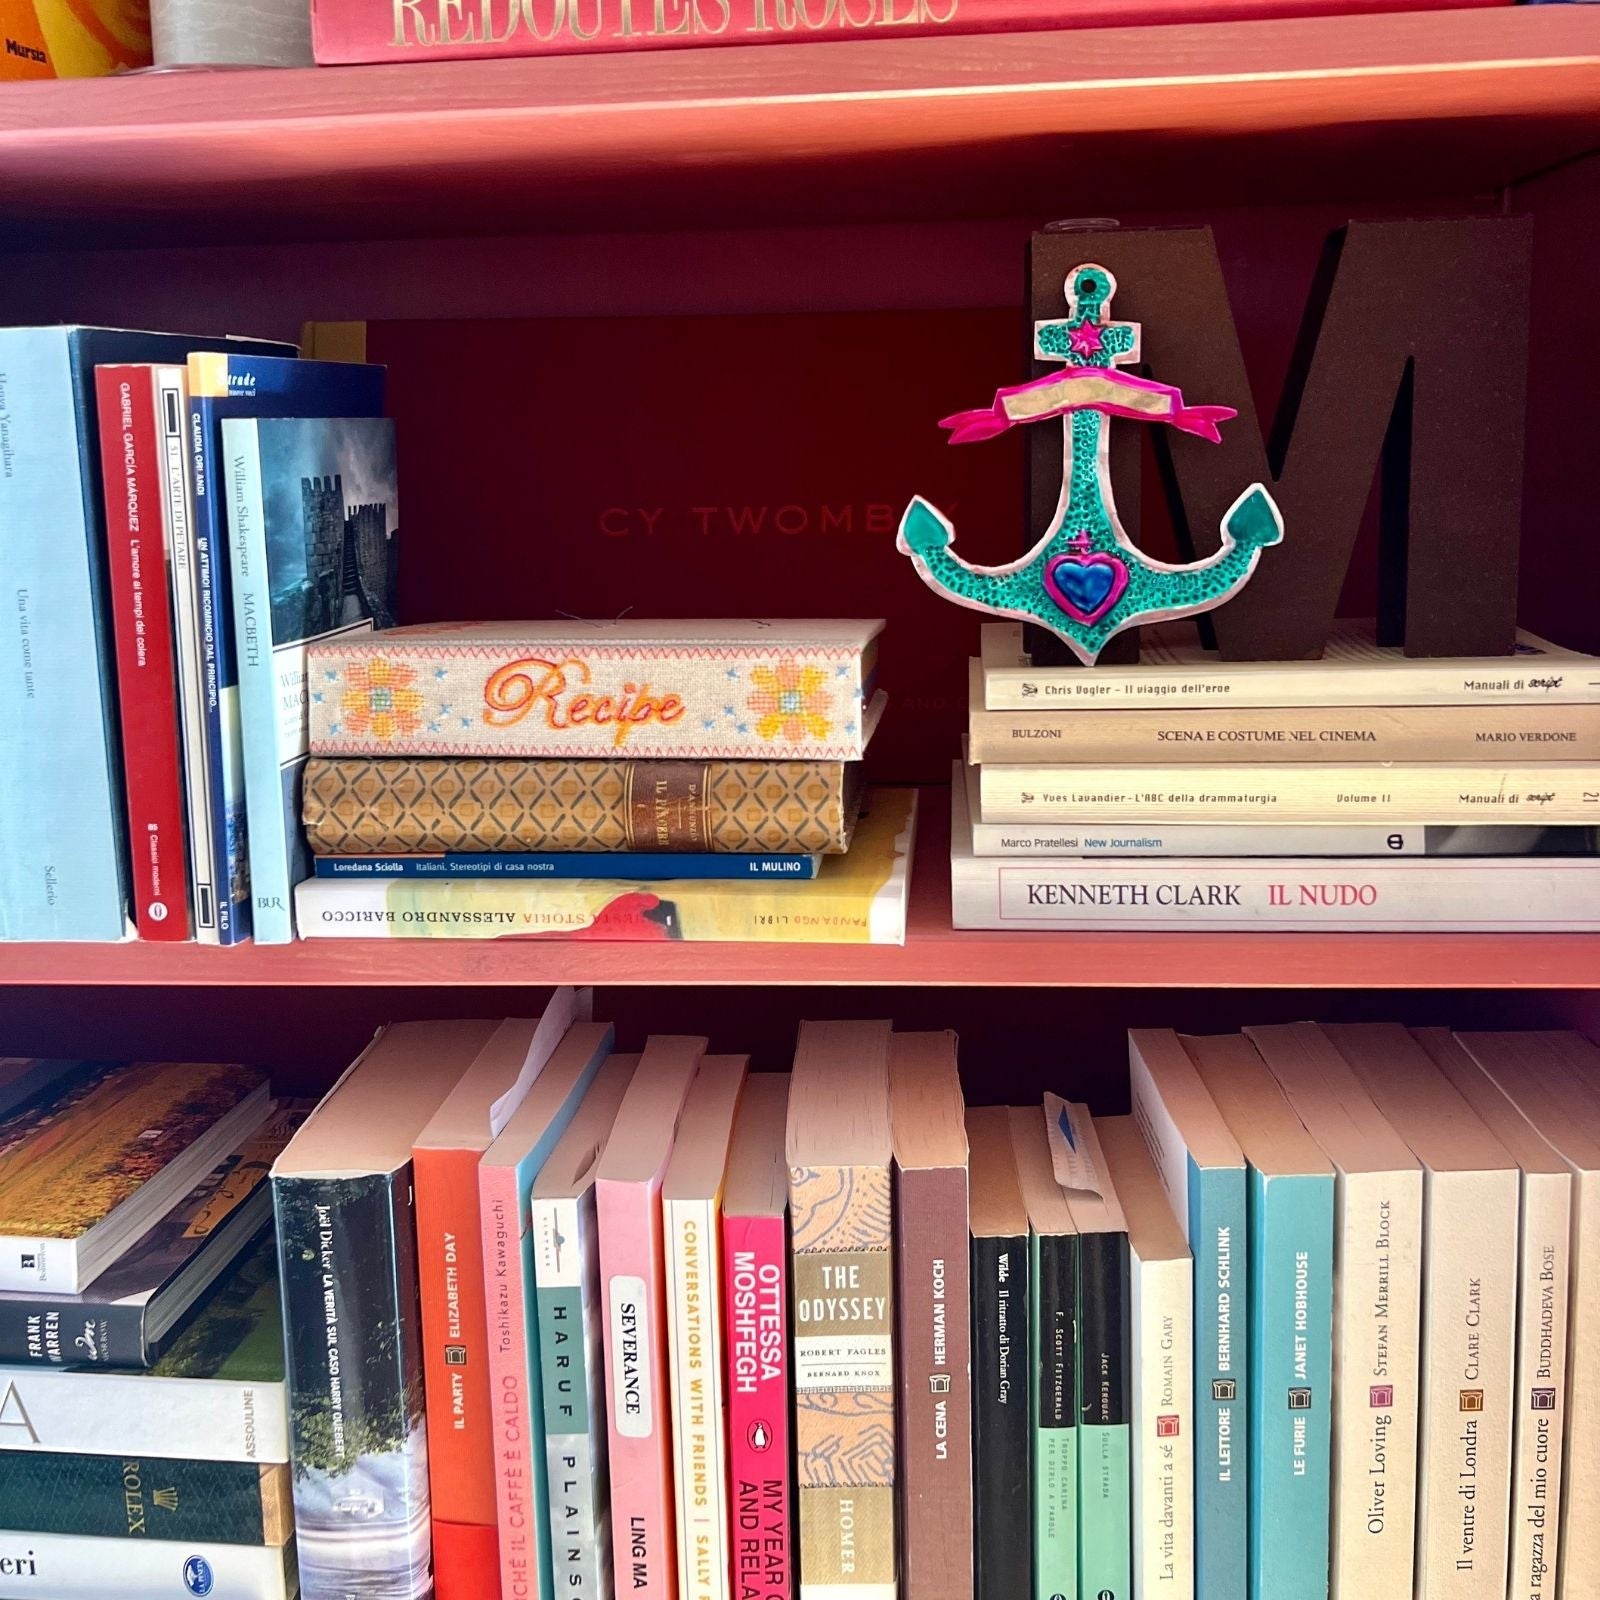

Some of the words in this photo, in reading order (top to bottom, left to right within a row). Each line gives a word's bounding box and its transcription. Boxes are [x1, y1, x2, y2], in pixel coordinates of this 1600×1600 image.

[5, 38, 47, 64] Mursia
[120, 382, 132, 431] GABRIEL
[0, 413, 15, 479] Yanagihara
[192, 413, 205, 454] CLAUDIA
[123, 433, 138, 475] GARCÍA
[195, 455, 206, 496] ORLANDI
[233, 455, 246, 504] William
[126, 478, 140, 532] MÁRQUEZ
[600, 507, 667, 537] CY
[692, 502, 959, 536] TWOMB
[175, 526, 187, 570] PETARE
[236, 505, 250, 577] Shakespeare
[130, 539, 141, 579] L'amore
[17, 588, 29, 612] Una
[133, 591, 145, 620] tempi
[202, 590, 213, 643] RICOMINCIO
[20, 615, 31, 635] vita
[135, 620, 147, 635] del
[243, 592, 259, 668] MACBETH
[22, 638, 31, 668] come
[136, 637, 149, 667] colera
[205, 644, 215, 662] DAL
[25, 671, 35, 699] tante
[1044, 684, 1072, 695] Chris
[1137, 684, 1177, 697] viaggio
[1181, 683, 1231, 694] dell'eroe
[1463, 679, 1510, 690] Manuali
[1513, 679, 1525, 690] di
[483, 657, 688, 747] Recipe
[1011, 729, 1062, 739] BULZONI
[1157, 730, 1204, 742] SCENA
[1206, 730, 1215, 741] E
[1218, 730, 1286, 742] COSTUME
[1288, 730, 1317, 742] NEL
[1319, 730, 1377, 742] CINEMA
[1475, 732, 1517, 742] MARIO
[1518, 732, 1577, 742] VERDONE
[1042, 793, 1067, 803] Yves
[1168, 793, 1195, 803] della
[1199, 793, 1277, 804] drammaturgia
[1336, 794, 1377, 803] Volume
[1458, 793, 1505, 804] Manuali
[1508, 793, 1519, 804] di
[1582, 791, 1600, 803] 21
[150, 834, 159, 865] Classici
[1001, 838, 1032, 848] Marco
[1034, 837, 1078, 848] Pratellesi
[1084, 838, 1107, 848] New
[1109, 837, 1163, 848] Journalism
[152, 865, 161, 896] moderni
[333, 862, 373, 872] Loredana
[374, 862, 404, 872] Sciolla
[415, 862, 448, 871] Italiani.
[450, 861, 492, 873] Stereotipi
[493, 862, 503, 871] di
[504, 864, 525, 872] casa
[526, 863, 555, 872] nostra
[749, 861, 759, 872] IL
[761, 861, 802, 872] MULINO
[44, 864, 56, 906] Sellerio
[1027, 884, 1149, 906] KENNETH
[1156, 884, 1242, 907] CLARK
[1268, 884, 1293, 907] IL
[1298, 884, 1378, 907] NUDO
[220, 910, 229, 930] FILO
[257, 896, 286, 911] BUR
[322, 910, 395, 923] BARICCO
[401, 912, 516, 923] ALESSANDRO
[522, 911, 586, 925] STORIA
[753, 915, 789, 925] LIBRI
[314, 1203, 332, 1229] Joël
[317, 1231, 335, 1270] Dicker
[444, 1232, 457, 1263] DAY
[492, 1199, 509, 1277] Kawaguchi
[998, 1252, 1010, 1283] Wilde
[1217, 1225, 1231, 1288] SCHLINK
[322, 1274, 334, 1288] LA
[684, 1220, 703, 1369] CONVERSATIONS
[822, 1265, 860, 1290] THE
[932, 1259, 946, 1300] KOCH
[1294, 1251, 1309, 1331] HOBHOUSE
[324, 1288, 338, 1325] VERITÀ
[446, 1266, 461, 1339] ELIZABETH
[497, 1282, 511, 1353] Toshikazu
[799, 1297, 886, 1322] ODYSSEY
[998, 1300, 1010, 1333] ritratto
[27, 1315, 43, 1358] FRANK
[326, 1325, 338, 1346] SUL
[733, 1251, 758, 1393] MOSHFEGH
[758, 1264, 782, 1381] OTTESSA
[933, 1303, 946, 1365] HERMAN
[999, 1334, 1010, 1344] di
[1217, 1293, 1231, 1372] BERNHARD
[328, 1348, 341, 1375] CASO
[553, 1305, 574, 1418] HARUF
[620, 1302, 640, 1415] SEVERANCE
[800, 1348, 842, 1358] ROBERT
[847, 1348, 887, 1356] FAGLES
[999, 1346, 1010, 1379] Dorian
[1294, 1335, 1308, 1380] JANET
[329, 1376, 342, 1412] HARRY
[451, 1372, 466, 1415] PARTY
[502, 1375, 521, 1442] CALDO
[689, 1378, 704, 1426] WITH
[998, 1380, 1011, 1405] Gray
[243, 1389, 256, 1459] ASSOULINE
[331, 1411, 346, 1458] QUEBERT
[453, 1416, 466, 1430] IL
[934, 1400, 948, 1439] CENA
[1218, 1407, 1231, 1466] LETTORE
[1293, 1416, 1306, 1457] FURIE
[935, 1441, 948, 1460] LA
[1159, 1444, 1173, 1459] sé
[1368, 1414, 1393, 1475] Loving
[1459, 1418, 1478, 1478] Londra
[1535, 1418, 1549, 1463] cuore
[692, 1434, 708, 1507] FRIENDS
[1102, 1465, 1110, 1499] STRADA
[1163, 1463, 1173, 1472] a
[1218, 1473, 1231, 1482] IL
[1293, 1459, 1306, 1476] LE
[1530, 1468, 1548, 1500] mio
[122, 1460, 146, 1535] ROLEX
[504, 1468, 525, 1528] CAFFÈ
[738, 1480, 760, 1531] AND
[762, 1480, 783, 1514] MY
[1061, 1477, 1069, 1511] CARINA
[1158, 1477, 1174, 1529] davanti
[1367, 1480, 1386, 1535] Oliver
[1458, 1484, 1476, 1500] di
[1048, 1505, 1056, 1539] PAROLE
[1462, 1504, 1476, 1555] ventre
[1527, 1504, 1546, 1529] del
[510, 1535, 526, 1550] IL
[630, 1516, 647, 1558] LING
[763, 1521, 784, 1585] YEAR
[838, 1498, 856, 1576] HOMER
[1159, 1533, 1174, 1559] vita
[632, 1562, 648, 1590] MA
[695, 1535, 712, 1587] SALLY
[1159, 1562, 1174, 1581] La
[1456, 1559, 1473, 1571] Il
[1530, 1532, 1548, 1589] ragazza
